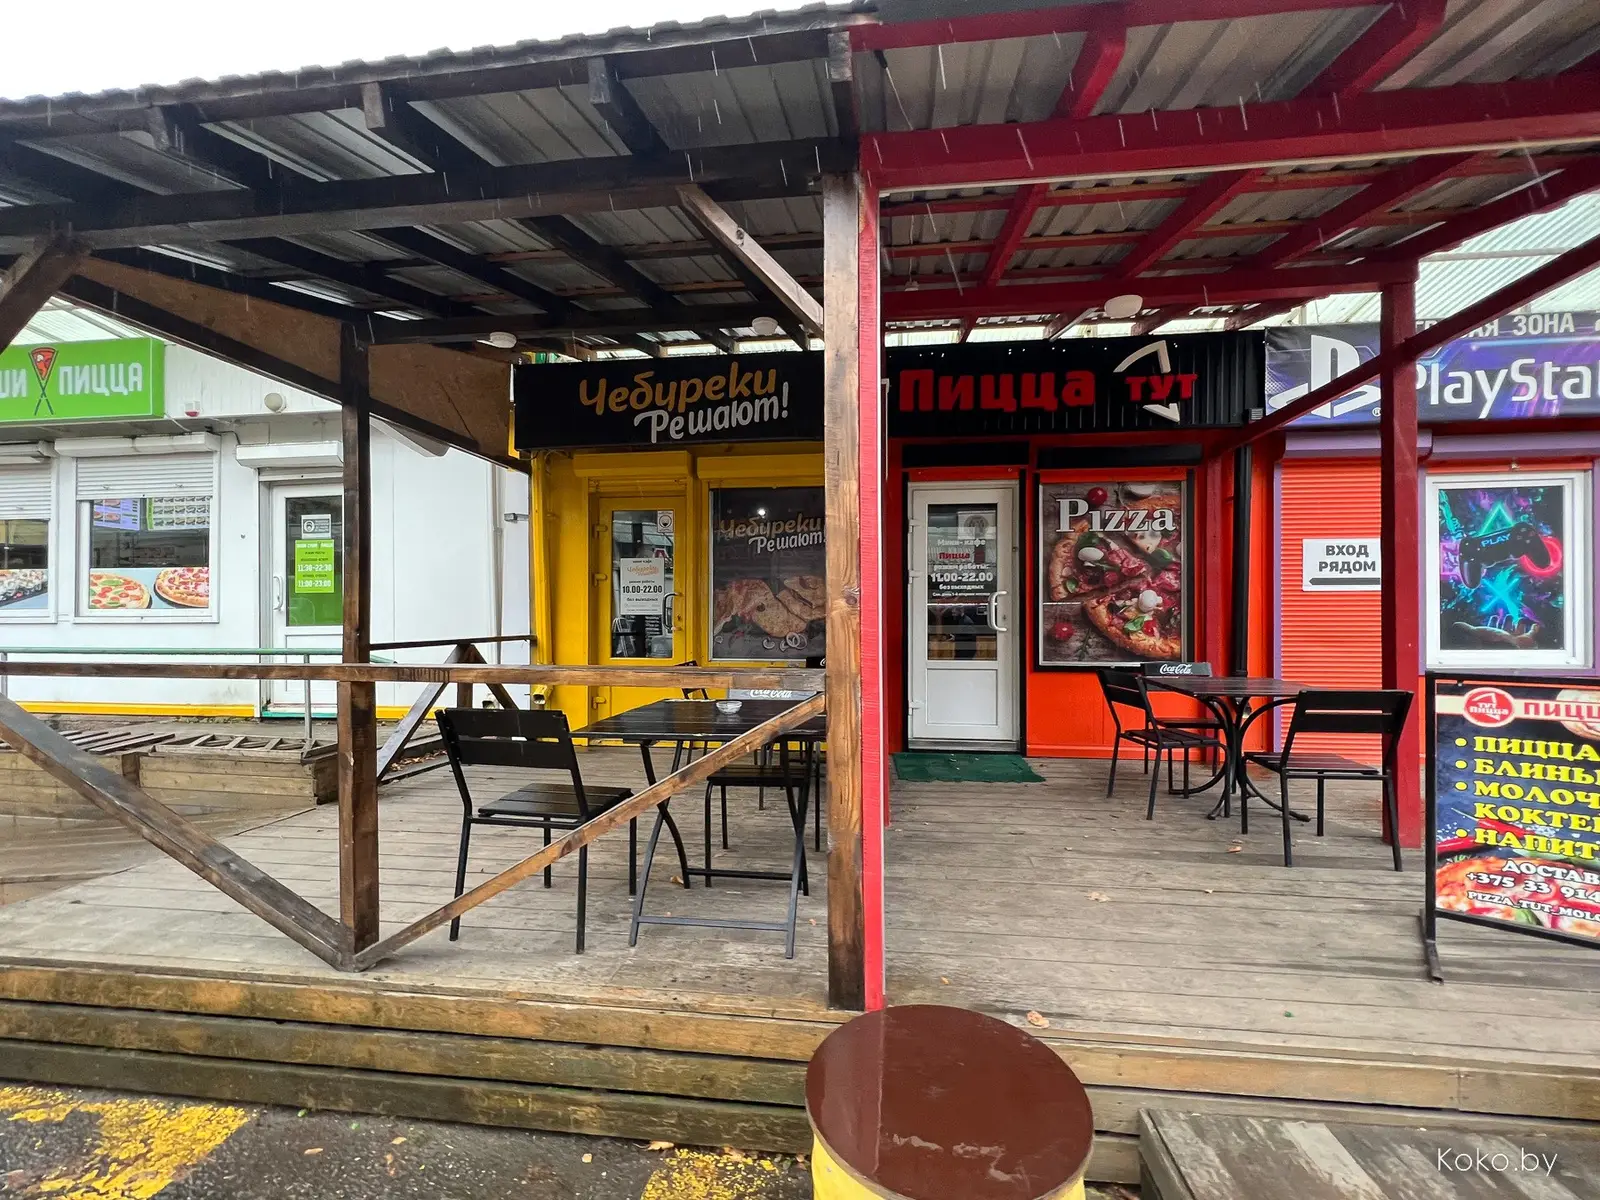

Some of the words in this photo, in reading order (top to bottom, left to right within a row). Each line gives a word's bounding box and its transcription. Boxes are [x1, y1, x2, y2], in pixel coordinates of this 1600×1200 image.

[1513, 313, 1575, 336] ЗОНА
[59, 362, 143, 396] ПИЦЦА
[579, 361, 776, 415] Чебуреки
[899, 369, 1096, 412] Пицца
[1416, 357, 1600, 419] laySta
[634, 382, 789, 443] Решают!
[718, 513, 821, 539] Чебуреки
[1055, 498, 1176, 532] Pizza
[1325, 545, 1370, 557] ВХОД
[1481, 533, 1511, 547] PLAY
[1318, 561, 1376, 574] РЯДОМ
[622, 585, 663, 594] 10.00-22.00
[1473, 736, 1600, 762] ПИЦЦА
[1474, 828, 1600, 859] НАПИТ
[1467, 872, 1515, 887] +375
[1524, 880, 1550, 894] 33
